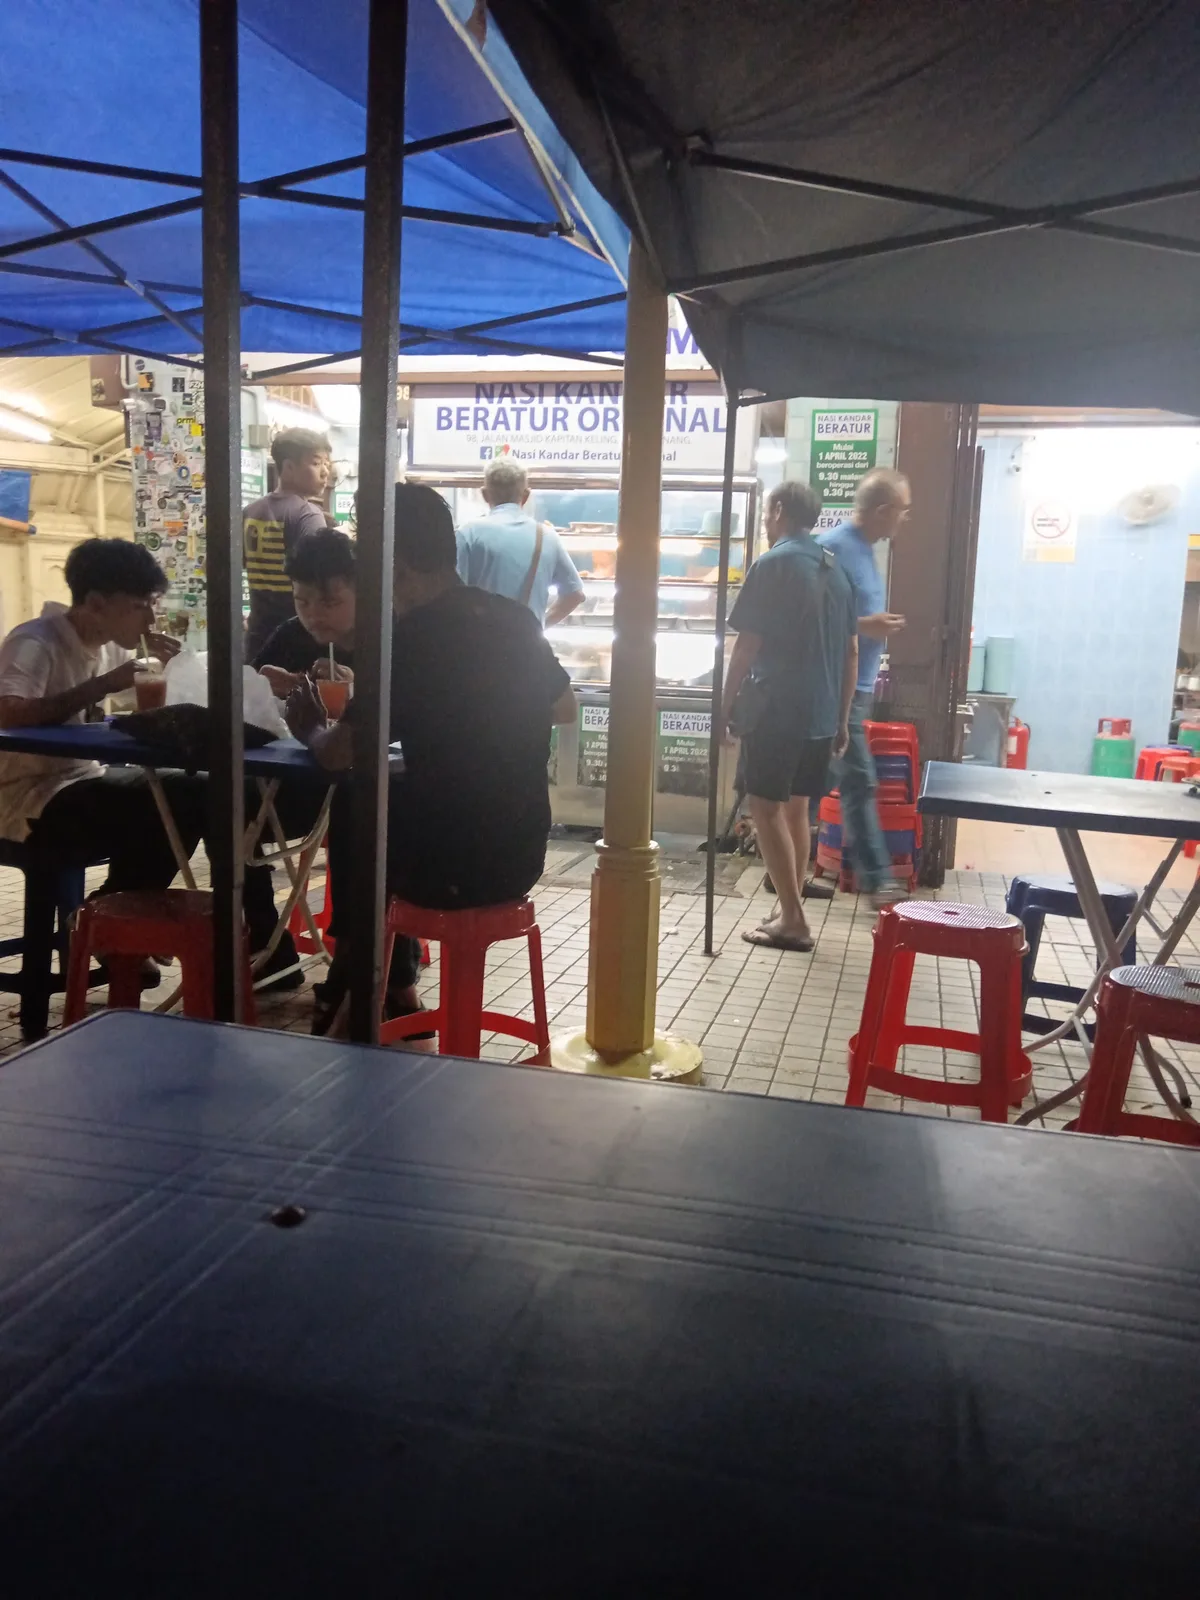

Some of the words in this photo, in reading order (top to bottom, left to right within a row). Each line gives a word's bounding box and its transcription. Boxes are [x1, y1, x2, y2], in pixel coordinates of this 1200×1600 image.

[475, 383, 545, 404] NASI
[554, 383, 689, 405] KANR
[436, 406, 569, 431] BERATUR
[577, 406, 727, 433] ORNAL
[817, 423, 871, 433] BERATUR
[481, 434, 508, 443] JALAN
[511, 434, 543, 443] MASJID
[545, 434, 582, 443] KAPITAN
[832, 443, 854, 451] Mulai
[512, 449, 536, 459] Nasi
[538, 449, 579, 460] Kandar
[582, 449, 622, 460] Beratu
[818, 452, 824, 460] 1
[824, 452, 847, 460] APRIL
[848, 452, 868, 460] 2022
[816, 461, 854, 469] beroperasi
[854, 461, 869, 469] dari
[818, 472, 839, 480] 9.30
[829, 481, 854, 489] hingga
[823, 488, 843, 497] 9.30
[584, 715, 610, 726] BERA
[662, 720, 711, 732] BERATUR
[669, 746, 689, 755] APRIL
[690, 747, 708, 756] 2022
